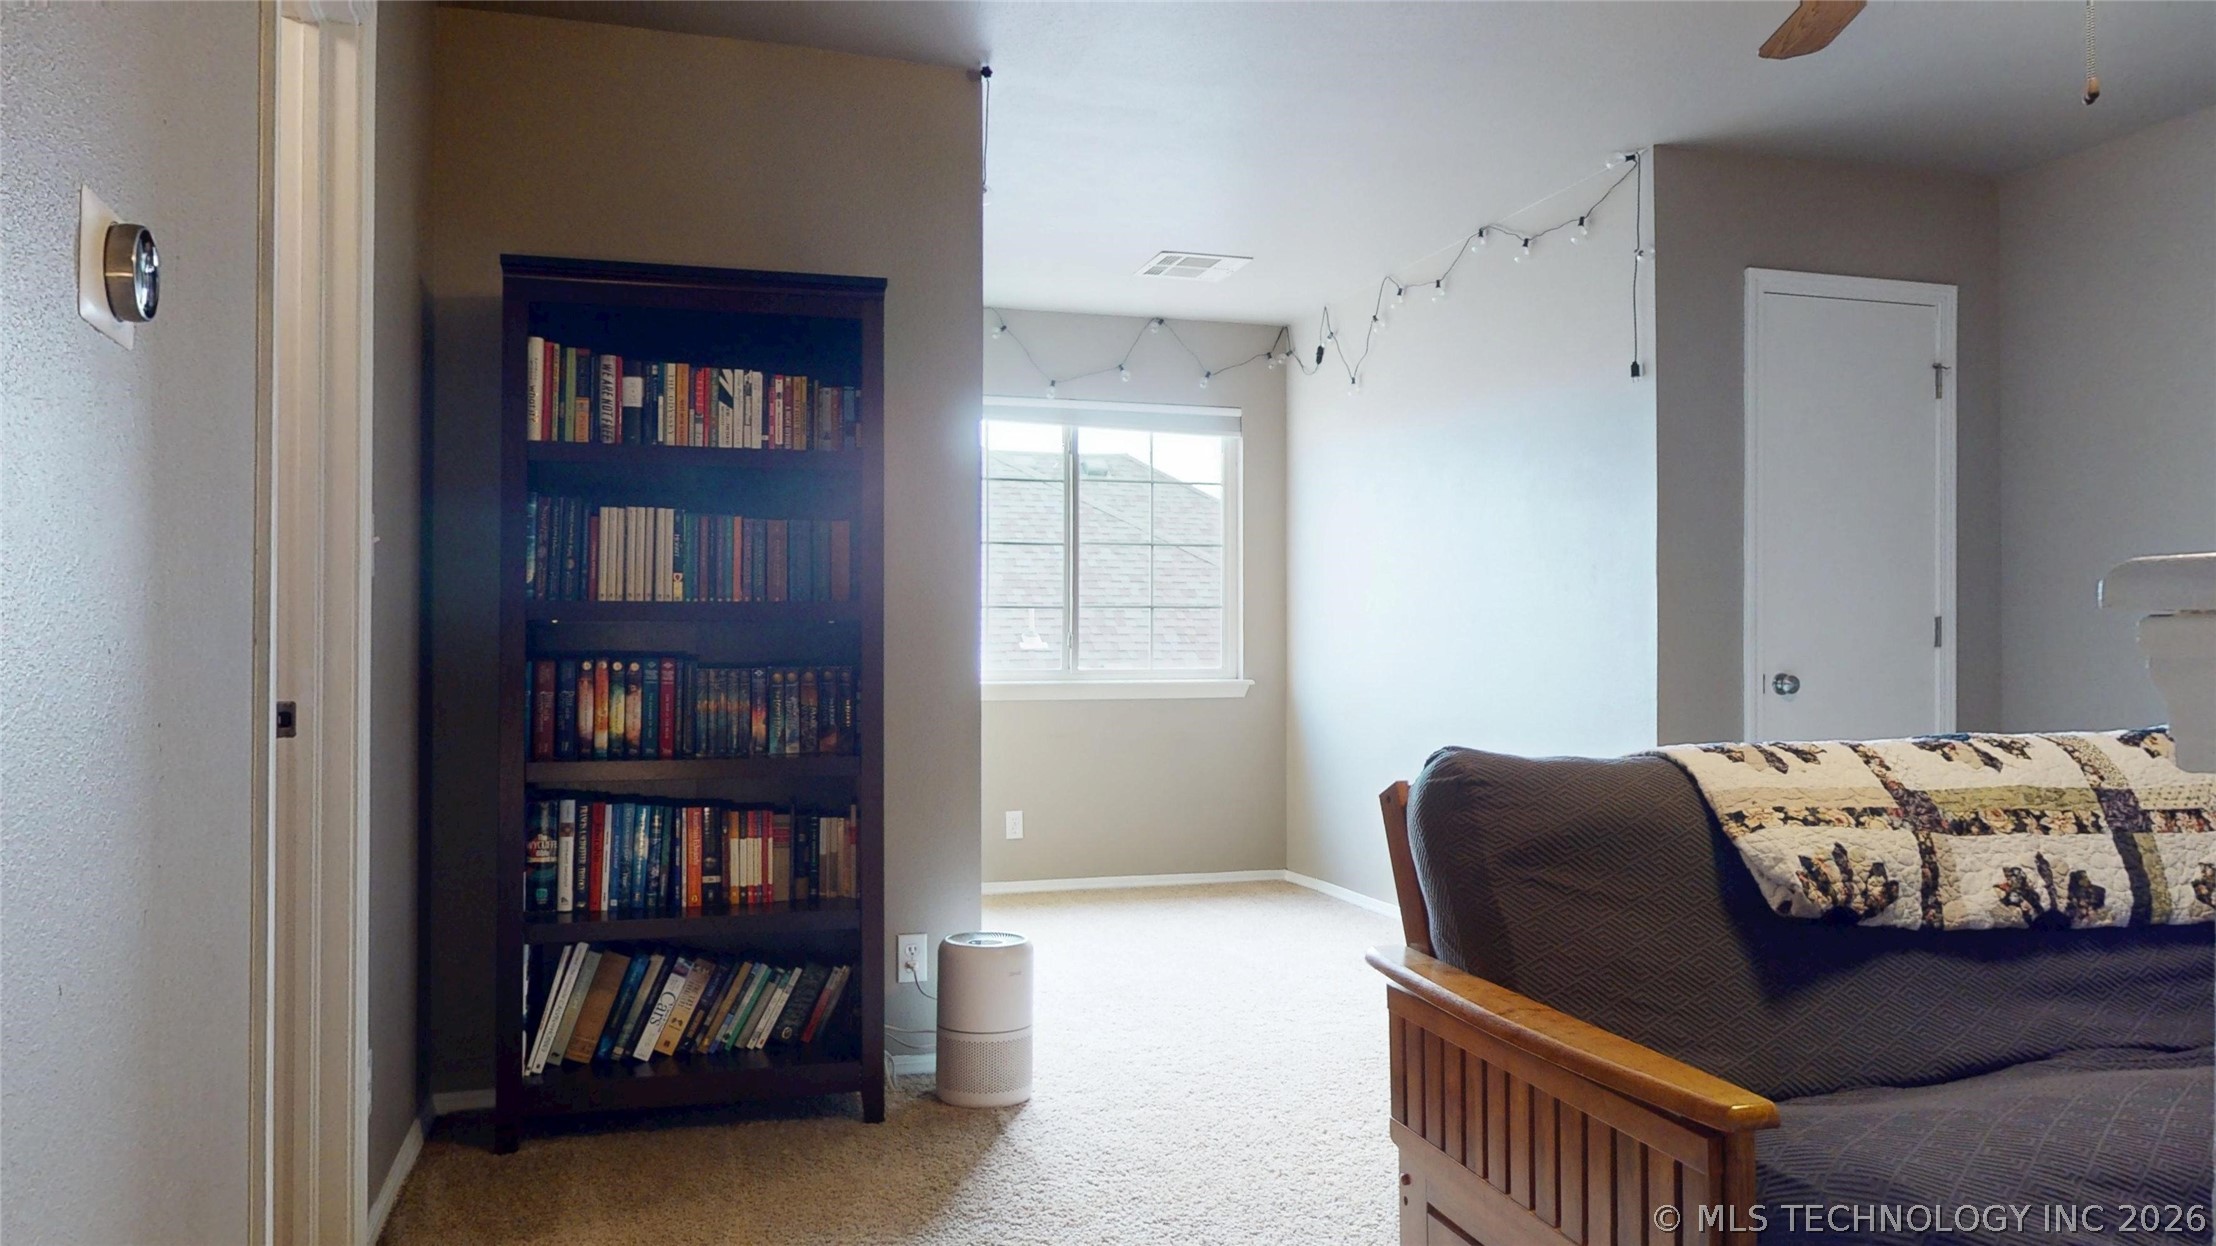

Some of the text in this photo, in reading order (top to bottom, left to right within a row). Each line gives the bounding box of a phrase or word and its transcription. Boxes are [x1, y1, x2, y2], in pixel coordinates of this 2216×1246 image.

[601, 364, 613, 441] WE ARE NOT FREE
[649, 990, 677, 1027] Cars
